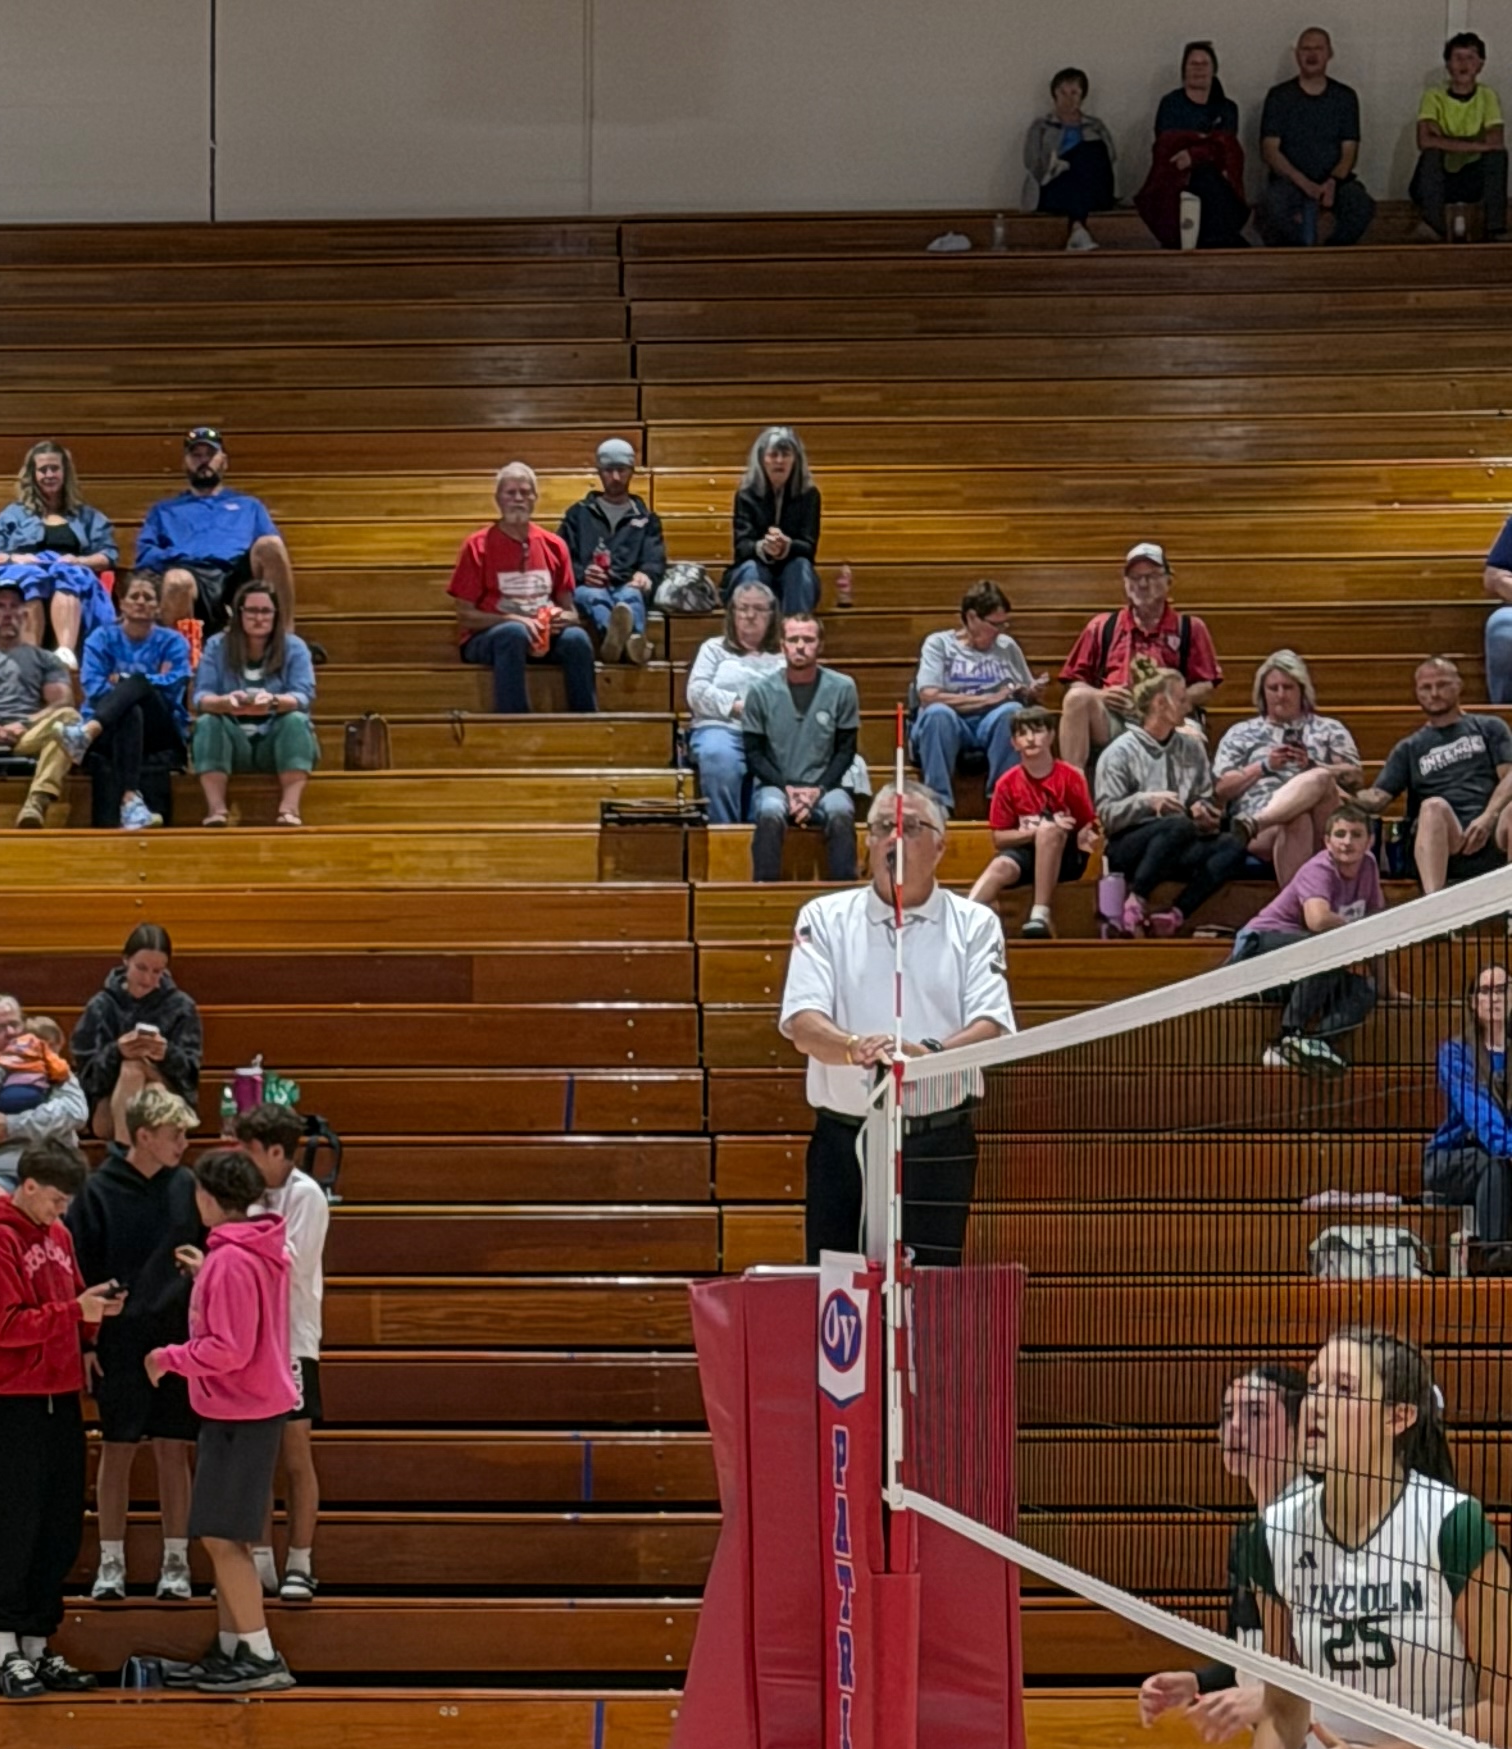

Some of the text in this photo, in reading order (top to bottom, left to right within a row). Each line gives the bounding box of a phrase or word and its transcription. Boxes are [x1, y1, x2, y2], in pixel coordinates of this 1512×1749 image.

[824, 1298, 857, 1364] OV
[1295, 1580, 1424, 1615] LINCOLN
[1320, 1614, 1397, 1671] 25
